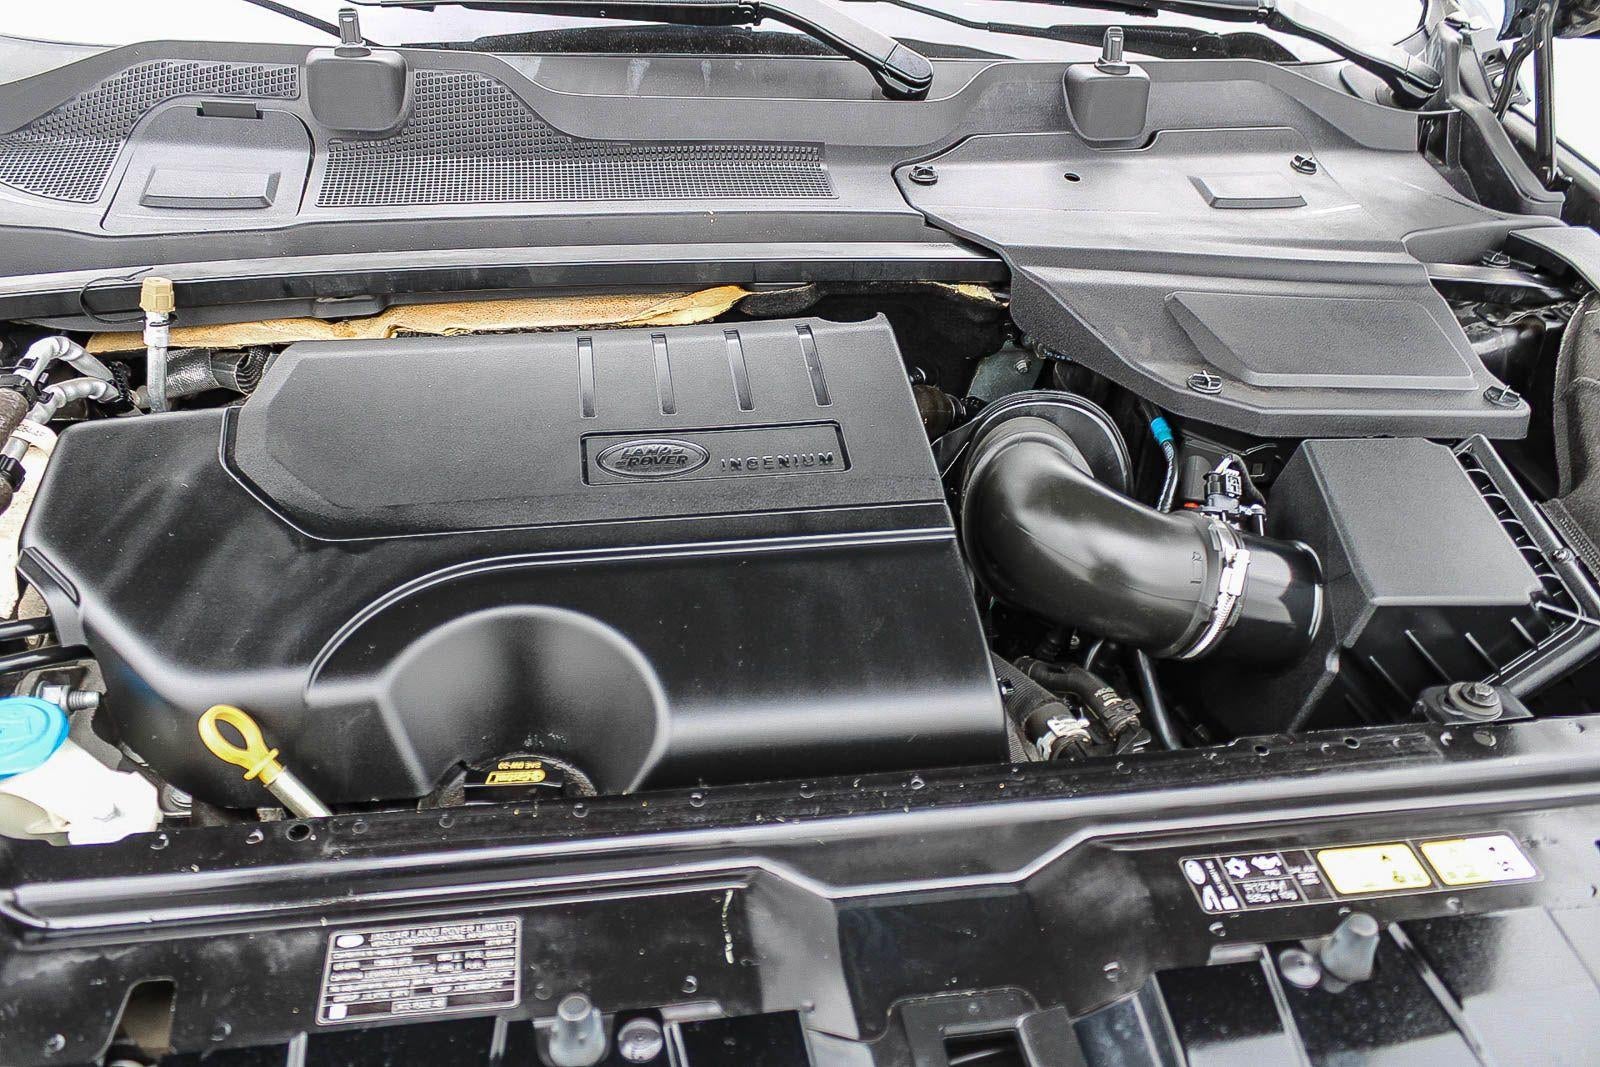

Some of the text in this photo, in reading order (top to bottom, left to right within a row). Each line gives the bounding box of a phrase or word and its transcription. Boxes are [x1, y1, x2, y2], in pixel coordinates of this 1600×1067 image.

[621, 446, 671, 457] LAND
[627, 455, 689, 467] ROVER
[720, 451, 835, 473] INGENIUM
[410, 928, 439, 938] LAND
[441, 925, 474, 935] ROVER
[476, 922, 514, 932] LIMITED
